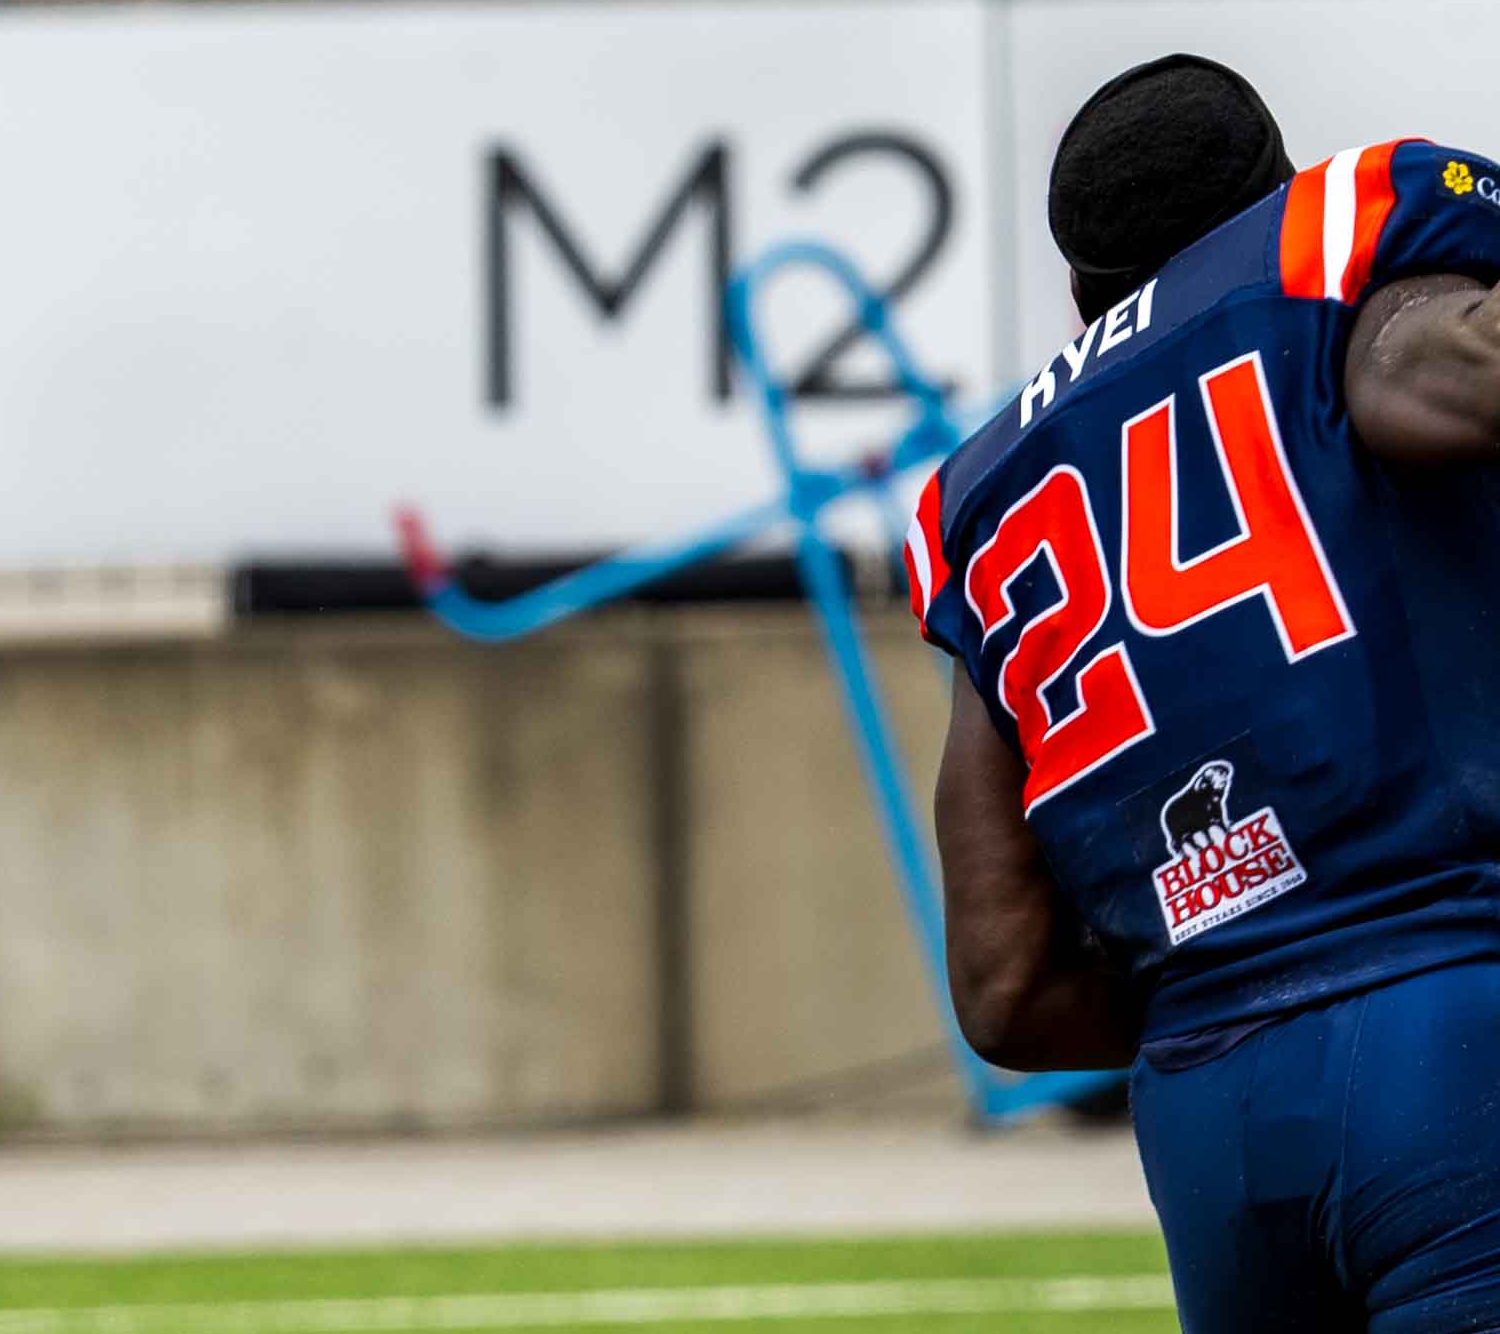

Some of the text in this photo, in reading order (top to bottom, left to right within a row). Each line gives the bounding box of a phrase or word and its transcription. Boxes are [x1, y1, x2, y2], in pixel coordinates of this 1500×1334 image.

[485, 131, 958, 405] M2
[966, 350, 1358, 819] 24
[1157, 813, 1279, 900] BLOCK
[1166, 842, 1296, 929] HOUSE
